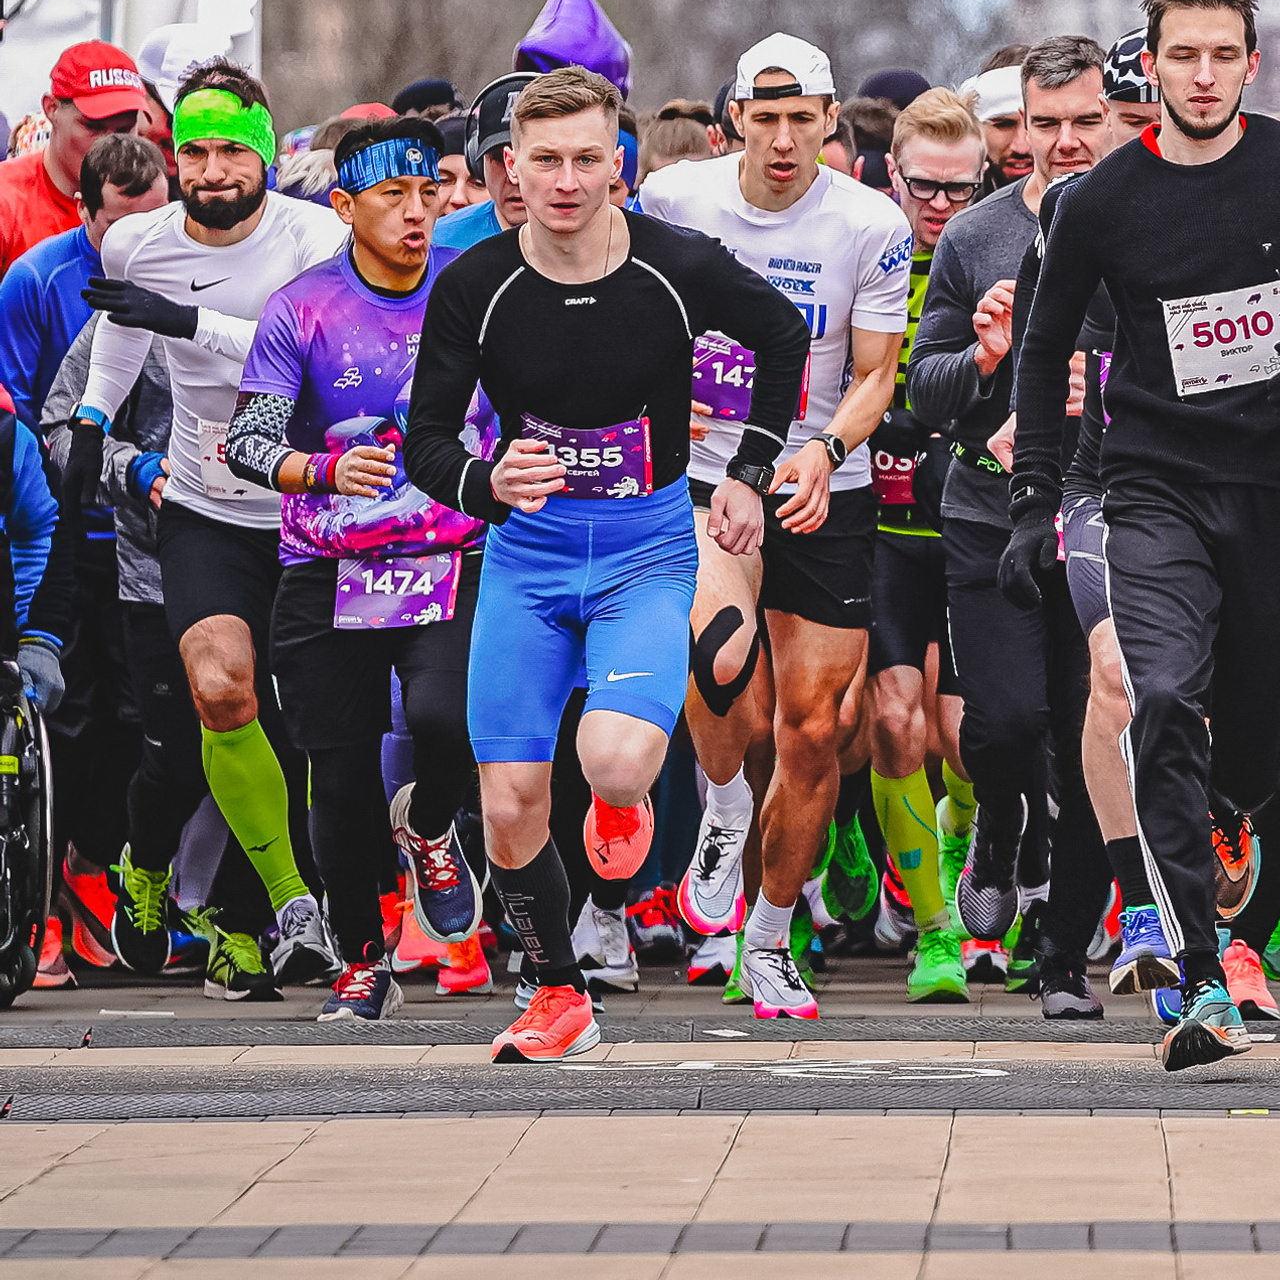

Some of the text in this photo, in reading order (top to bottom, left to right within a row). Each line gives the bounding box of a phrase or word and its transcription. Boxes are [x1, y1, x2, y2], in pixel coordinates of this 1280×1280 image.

[1192, 310, 1274, 348] 5010
[1220, 344, 1254, 358] ВИКТОР
[567, 469, 600, 477] СЕРГЕЙ
[361, 569, 434, 596] 1474
